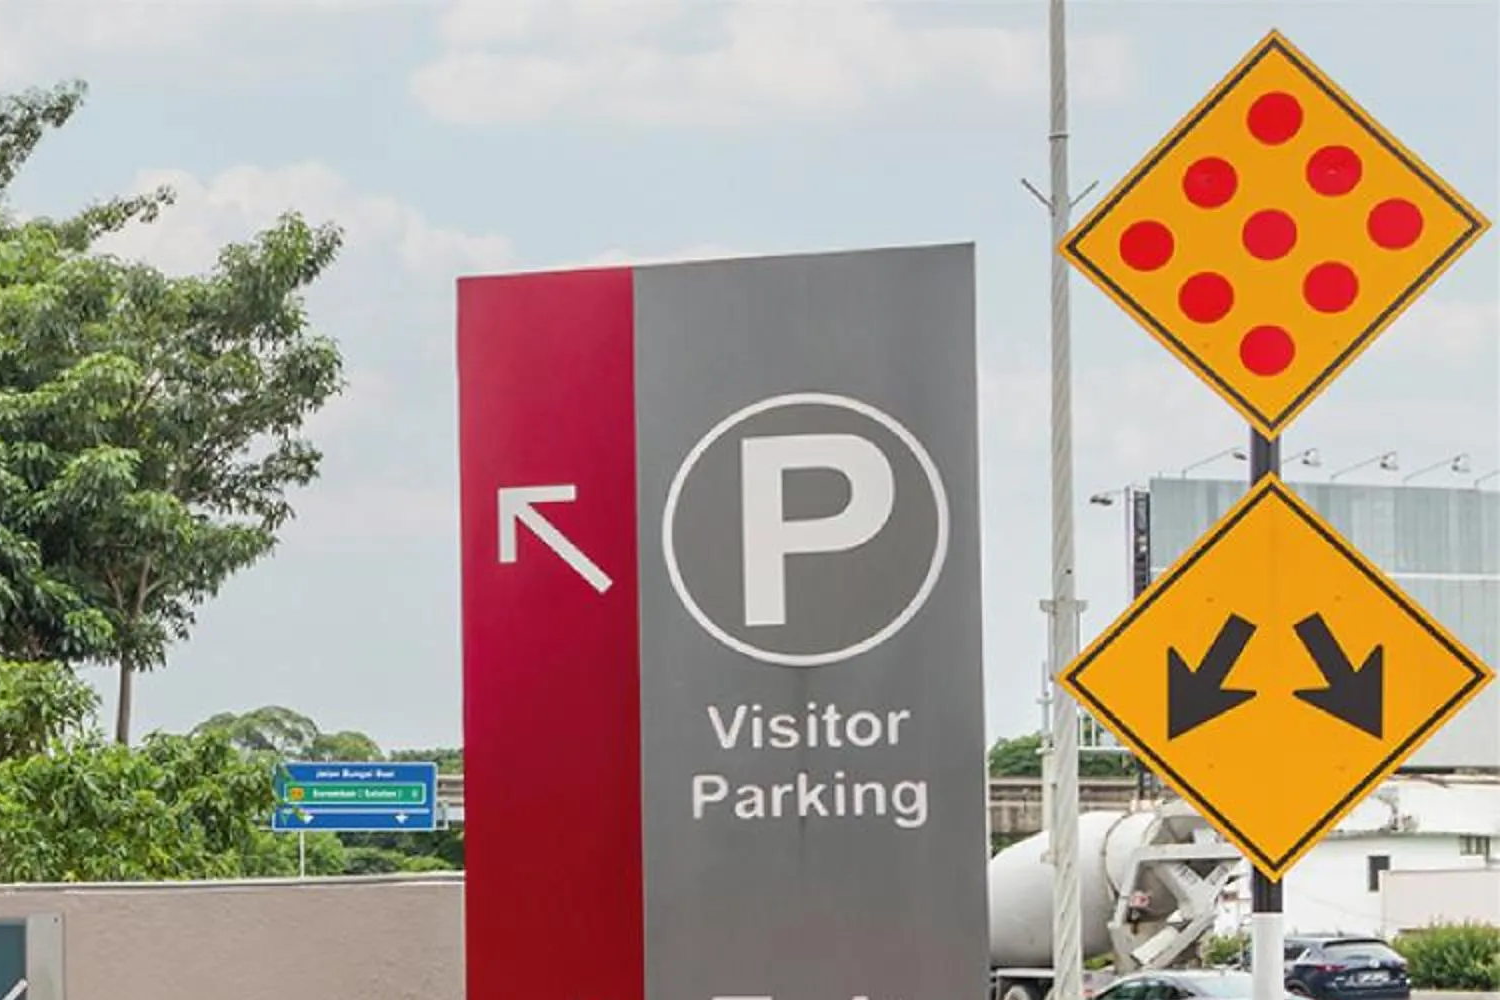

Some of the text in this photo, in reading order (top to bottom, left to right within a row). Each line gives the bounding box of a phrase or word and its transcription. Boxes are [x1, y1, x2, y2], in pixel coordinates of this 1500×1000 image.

[741, 433, 895, 627] P
[708, 703, 911, 749] Visitor
[692, 772, 929, 828] Parking
